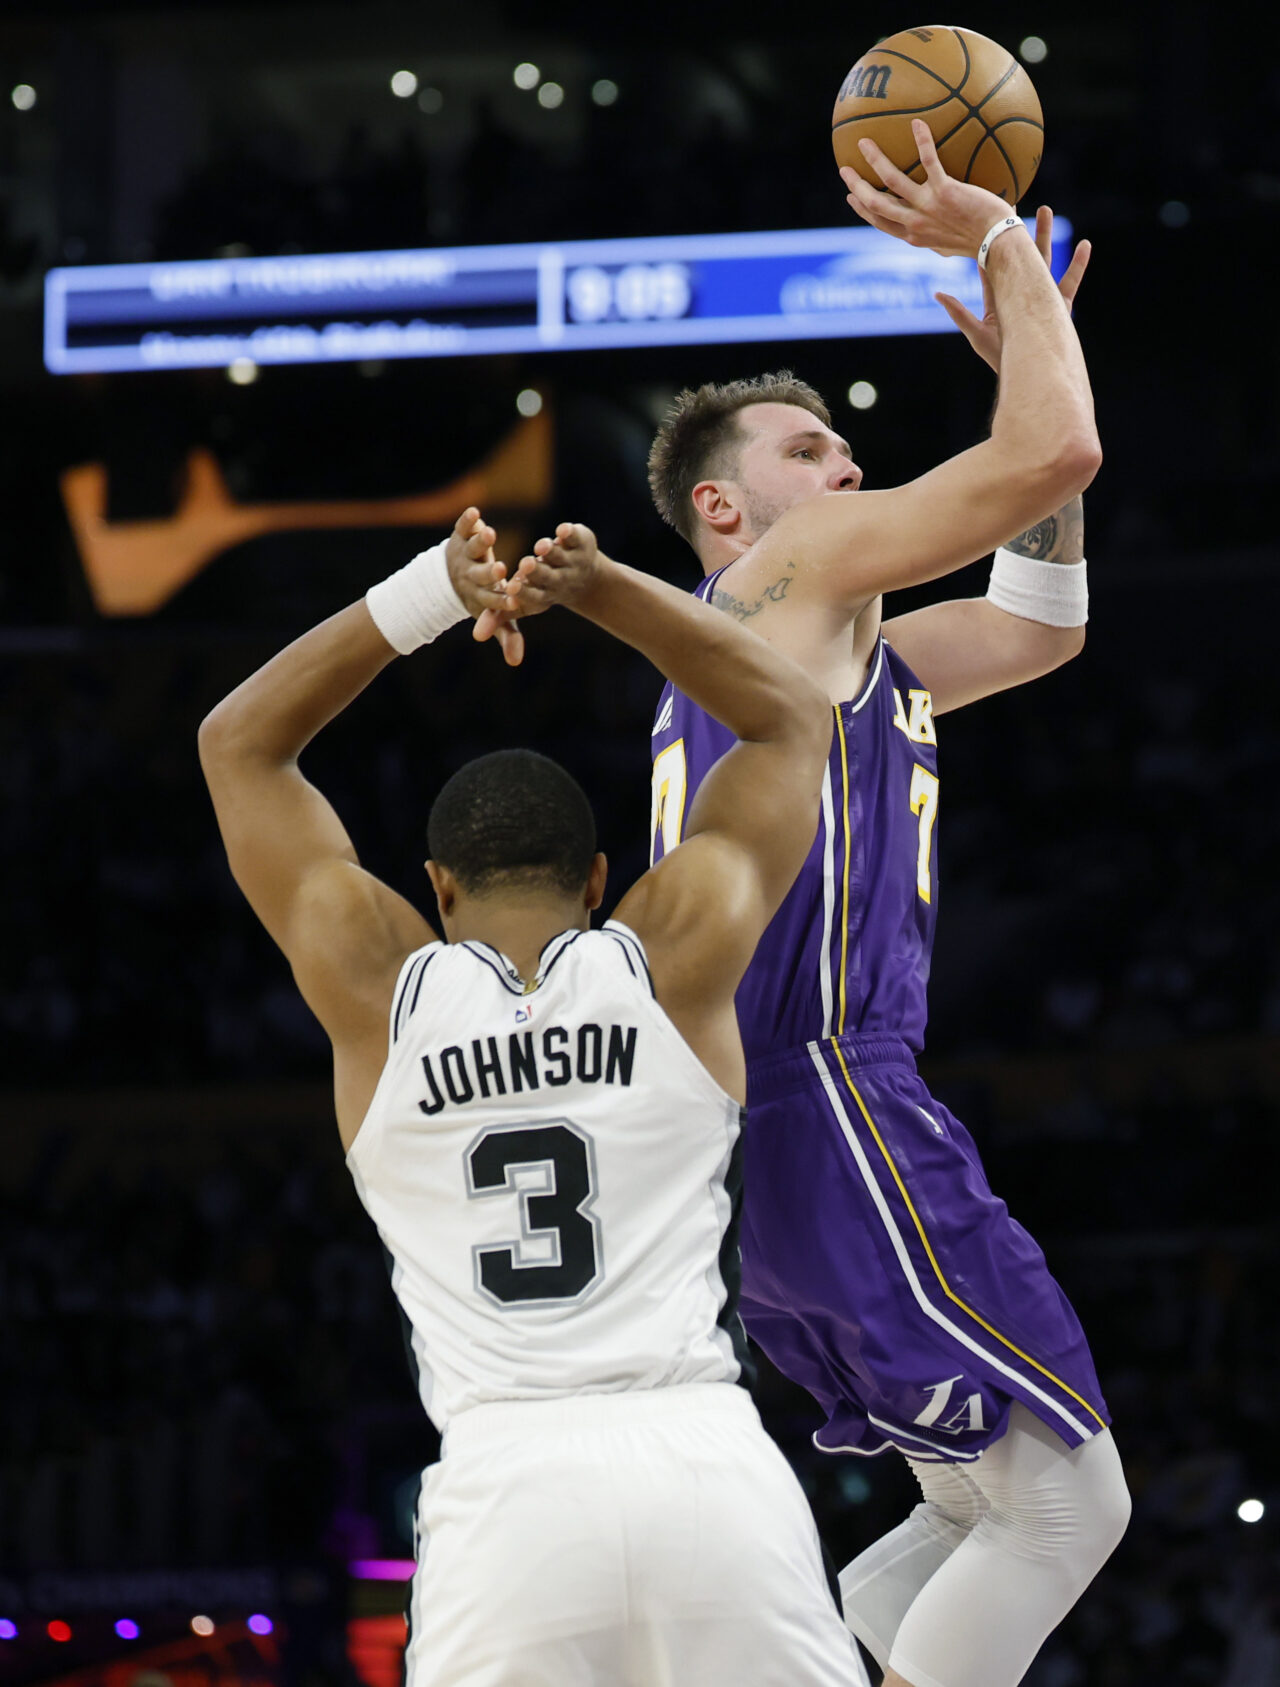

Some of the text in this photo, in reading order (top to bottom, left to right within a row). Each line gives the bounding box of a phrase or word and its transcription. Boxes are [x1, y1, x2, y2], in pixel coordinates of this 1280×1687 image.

[418, 1023, 638, 1116] JOHNSON
[463, 1117, 605, 1312] 3
[913, 1374, 991, 1436] LA
